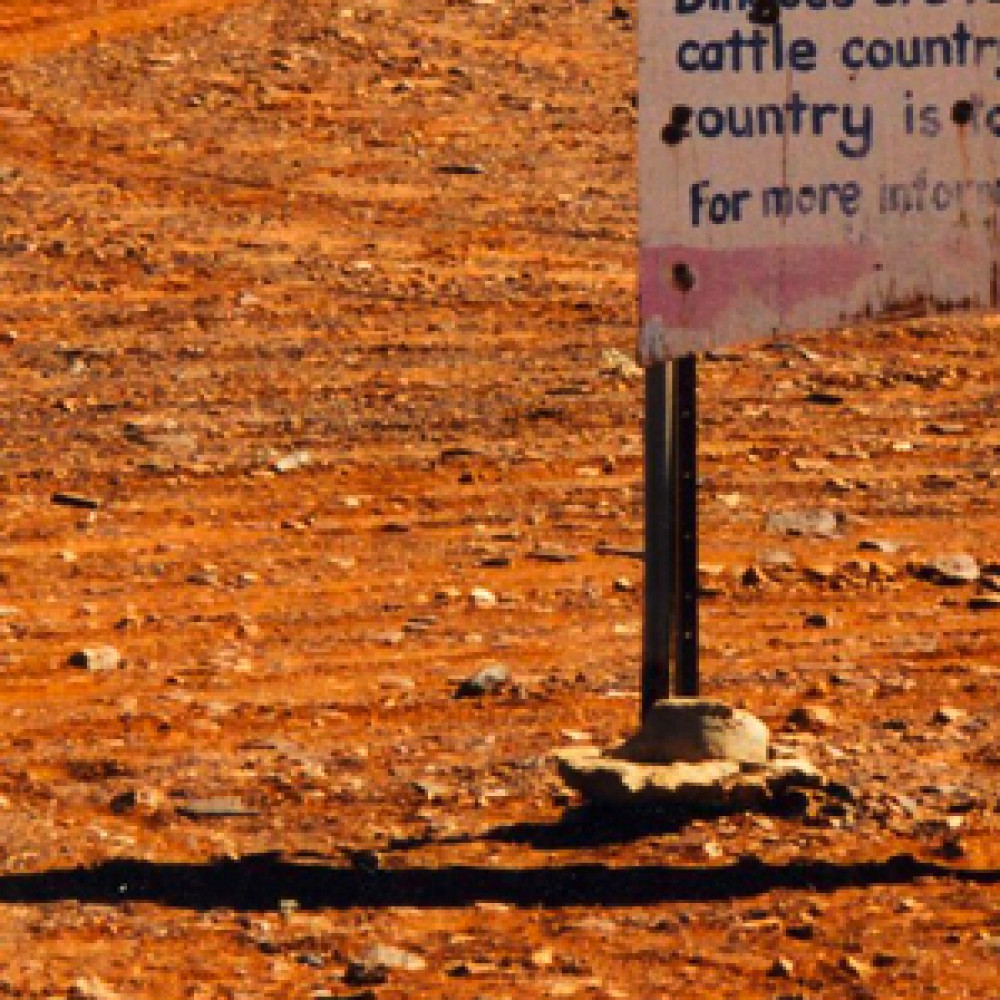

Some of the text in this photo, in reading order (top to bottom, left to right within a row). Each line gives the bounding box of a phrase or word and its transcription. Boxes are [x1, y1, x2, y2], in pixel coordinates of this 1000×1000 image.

[676, 22, 818, 72] cattle
[903, 90, 944, 137] is
[762, 181, 861, 217] more
